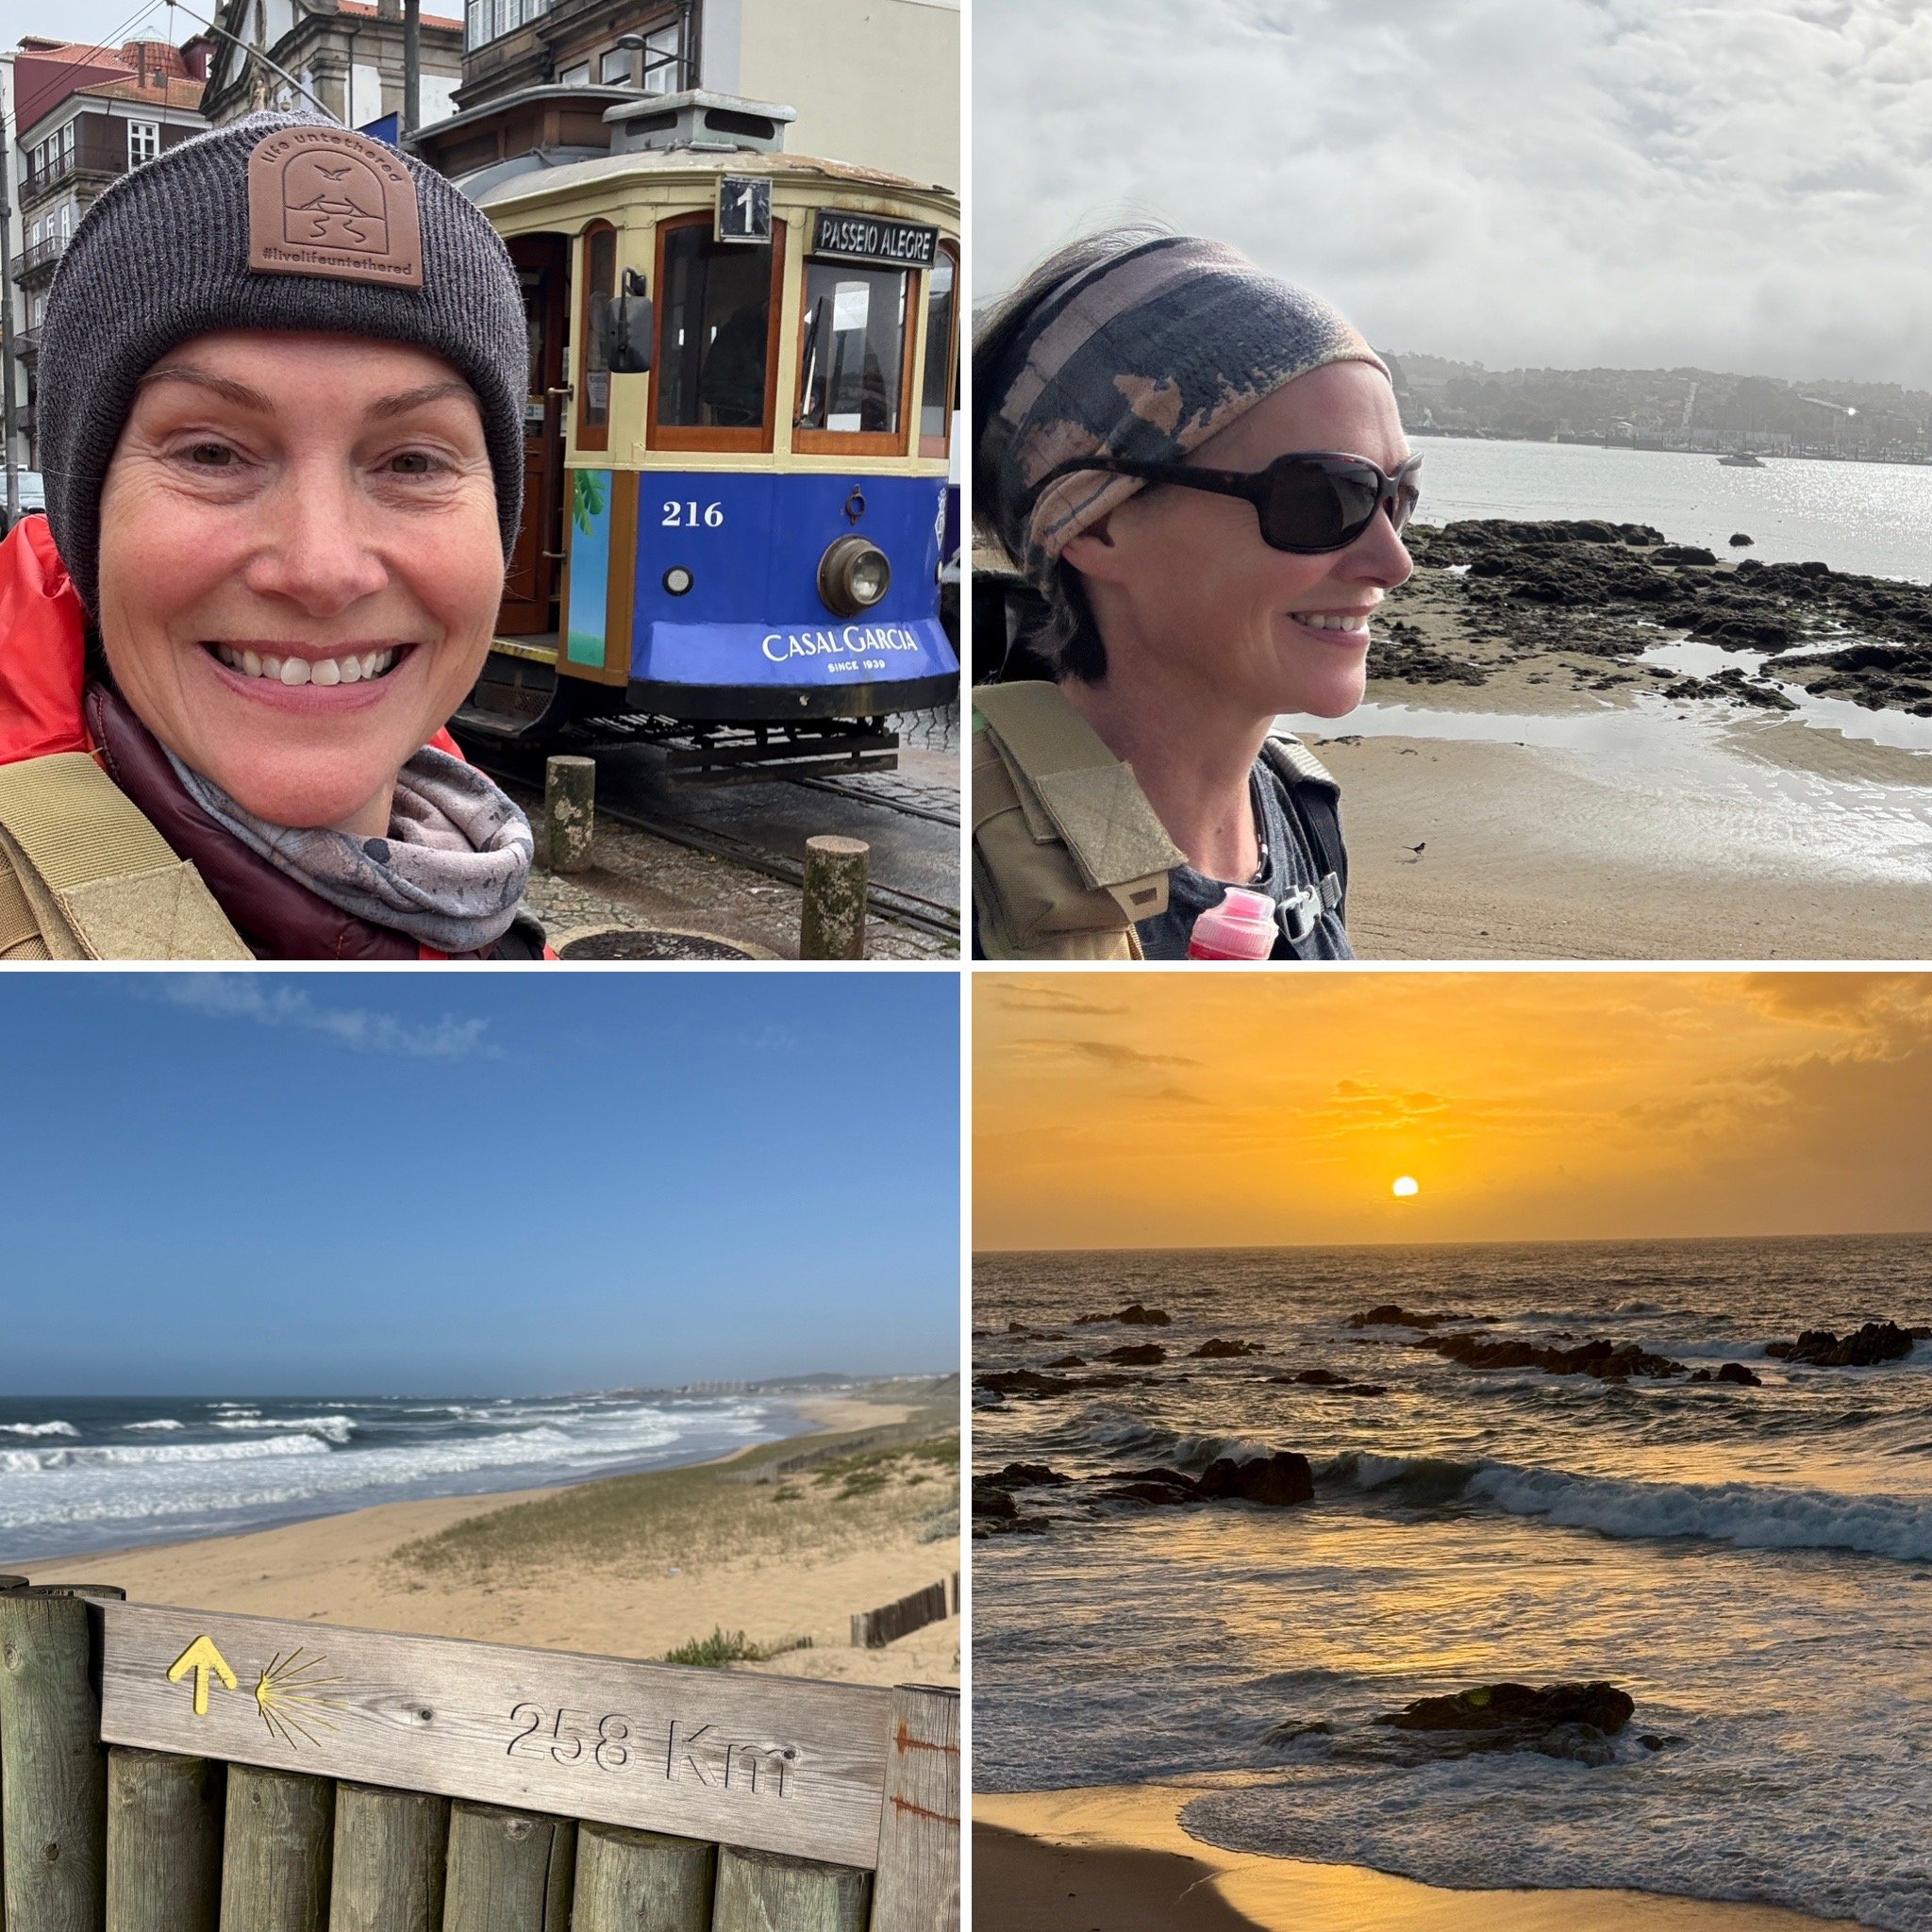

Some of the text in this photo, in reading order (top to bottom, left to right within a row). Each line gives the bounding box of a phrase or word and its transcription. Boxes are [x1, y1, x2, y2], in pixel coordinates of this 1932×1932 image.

[260, 133, 403, 182] life untethered
[737, 187, 753, 233] 1
[821, 219, 932, 260] PASSEIO ALEGRE
[262, 247, 412, 275] #livelifeuntethered
[661, 500, 724, 527] 216
[762, 625, 918, 662] CASAL GARCIA
[827, 658, 886, 673] SINCE 1939
[507, 1702, 795, 1798] 258 Km
